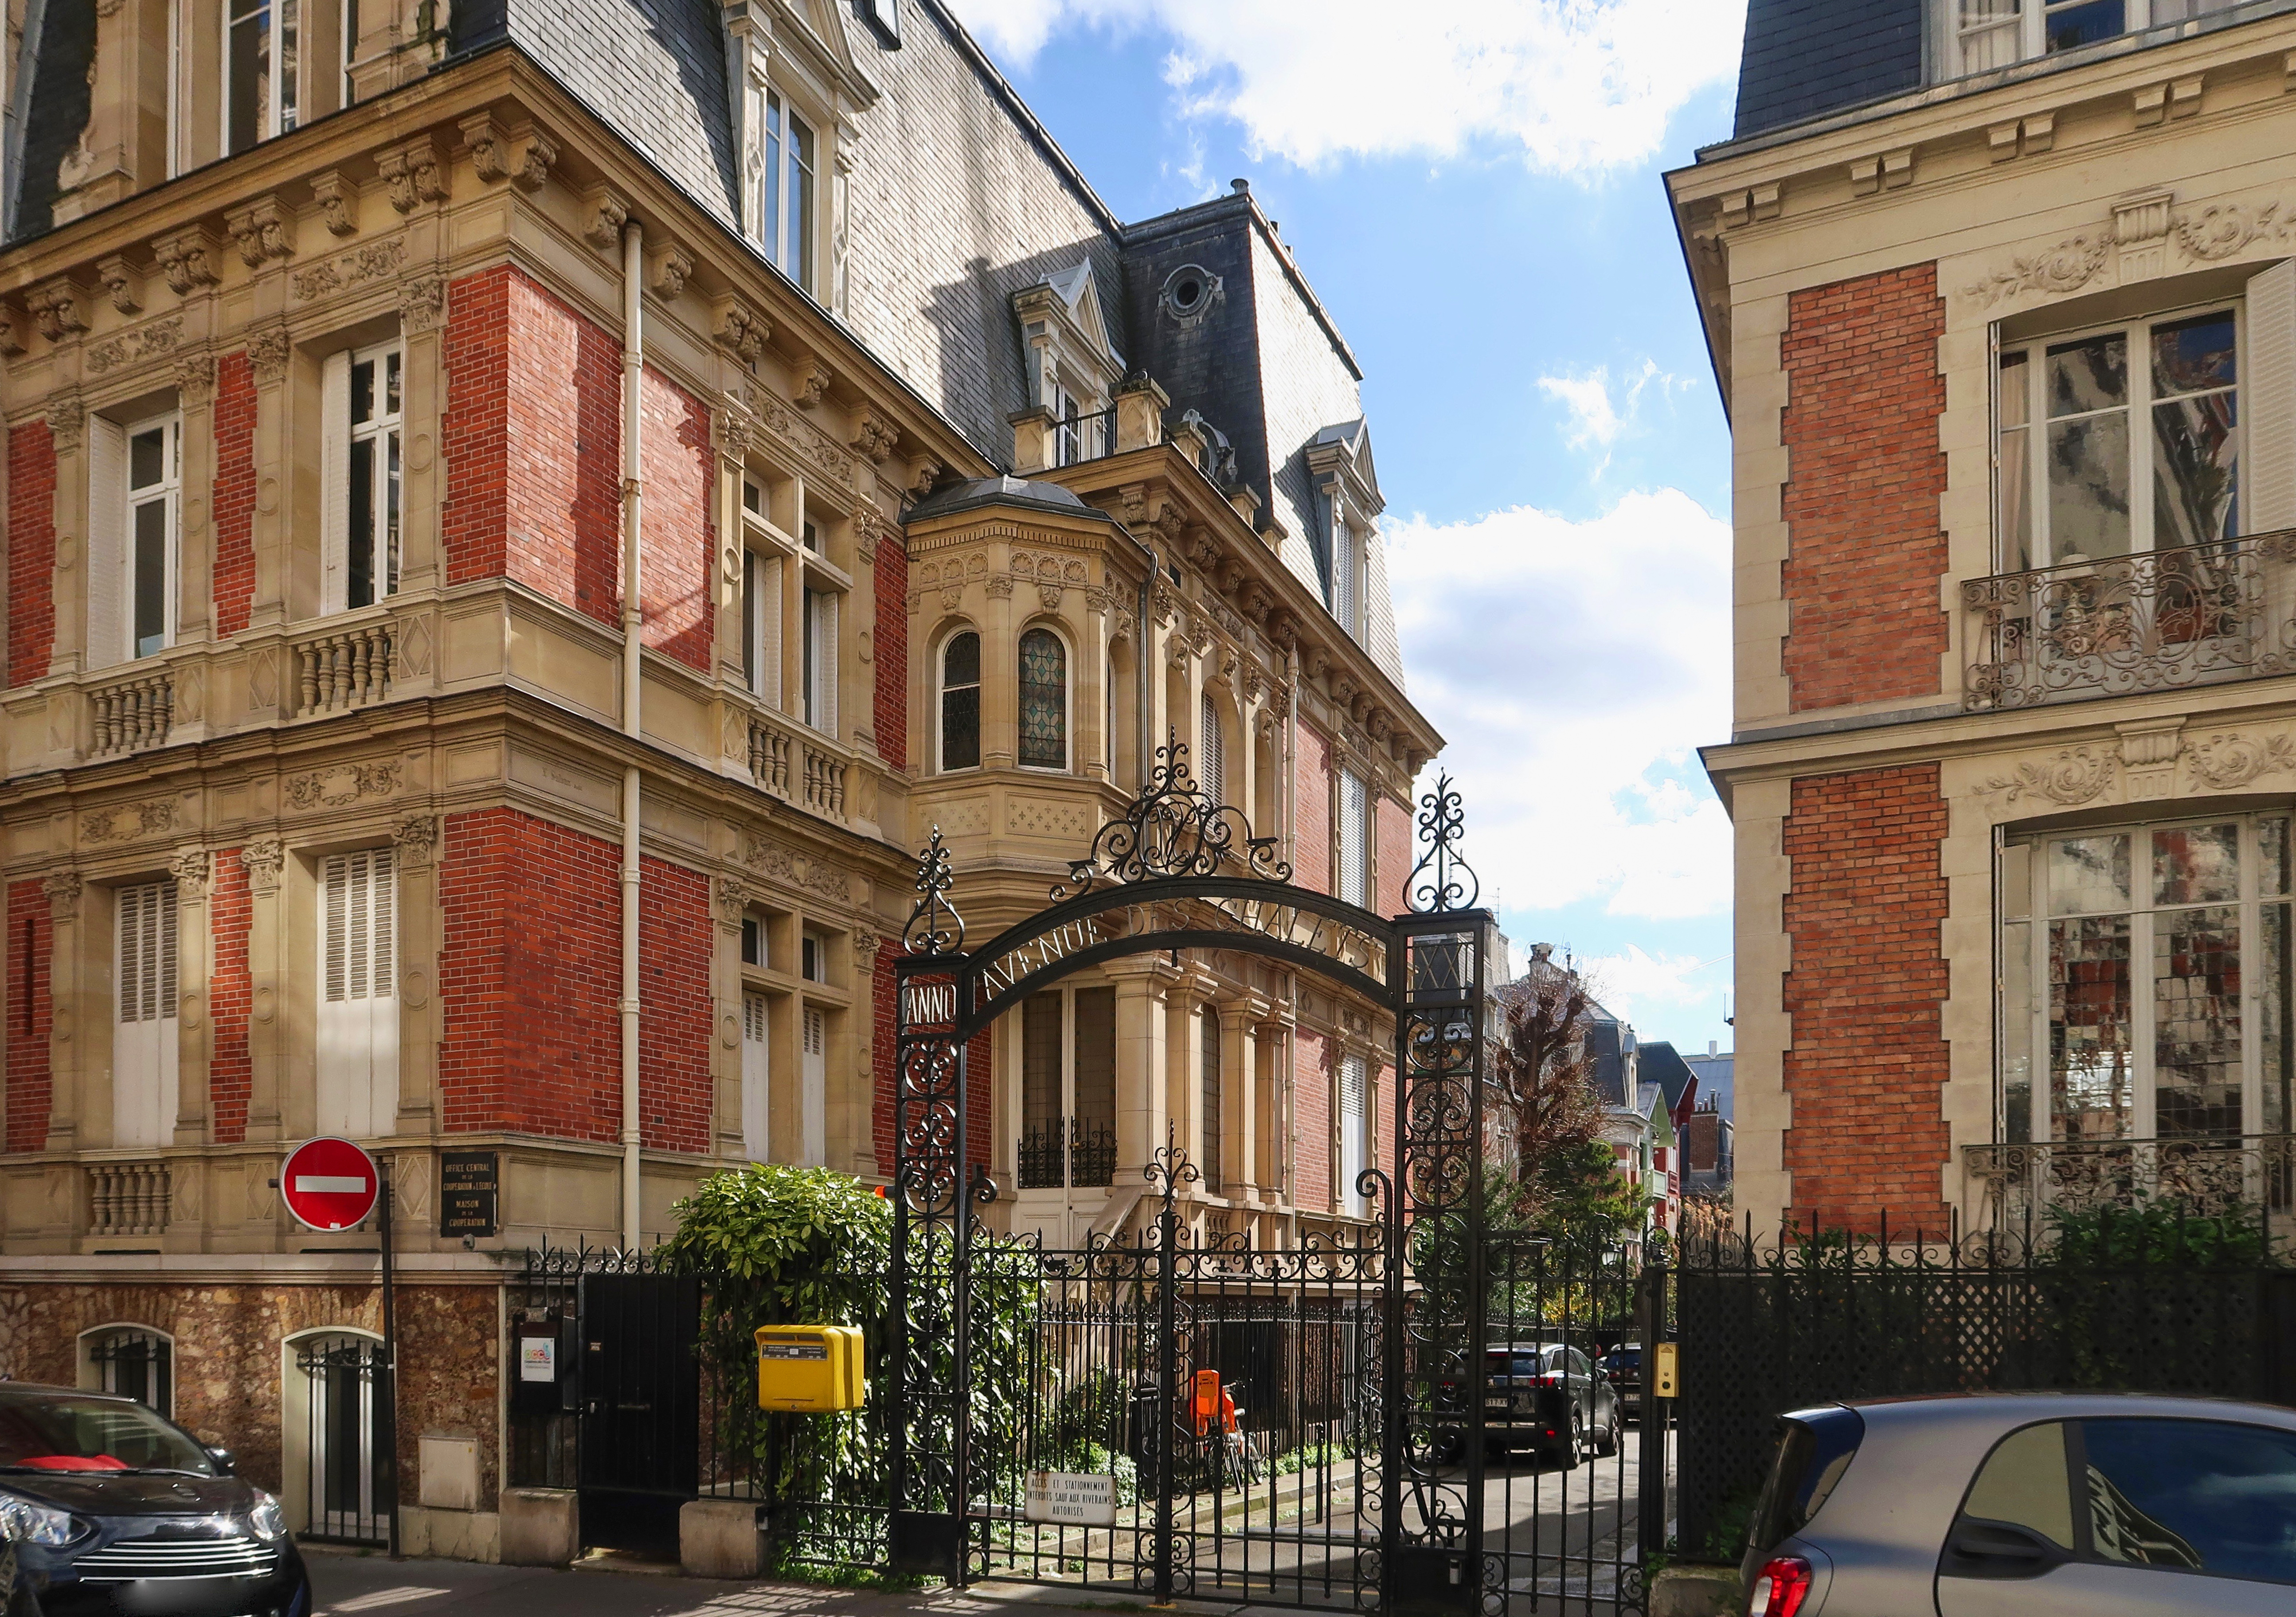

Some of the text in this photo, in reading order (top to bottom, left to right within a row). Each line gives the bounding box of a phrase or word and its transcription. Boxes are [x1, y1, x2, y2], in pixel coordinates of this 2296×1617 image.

[982, 897, 1377, 1001] AVENUE DES CHALETS
[906, 984, 957, 1024] ANNO
[446, 1163, 489, 1172] OFFICE CENTRAL
[1053, 1480, 1060, 1489] ET
[1065, 1480, 1108, 1492] STATIONNEMENT
[1027, 1491, 1112, 1505] INTERDITS SAUF AUX RIVERAINS
